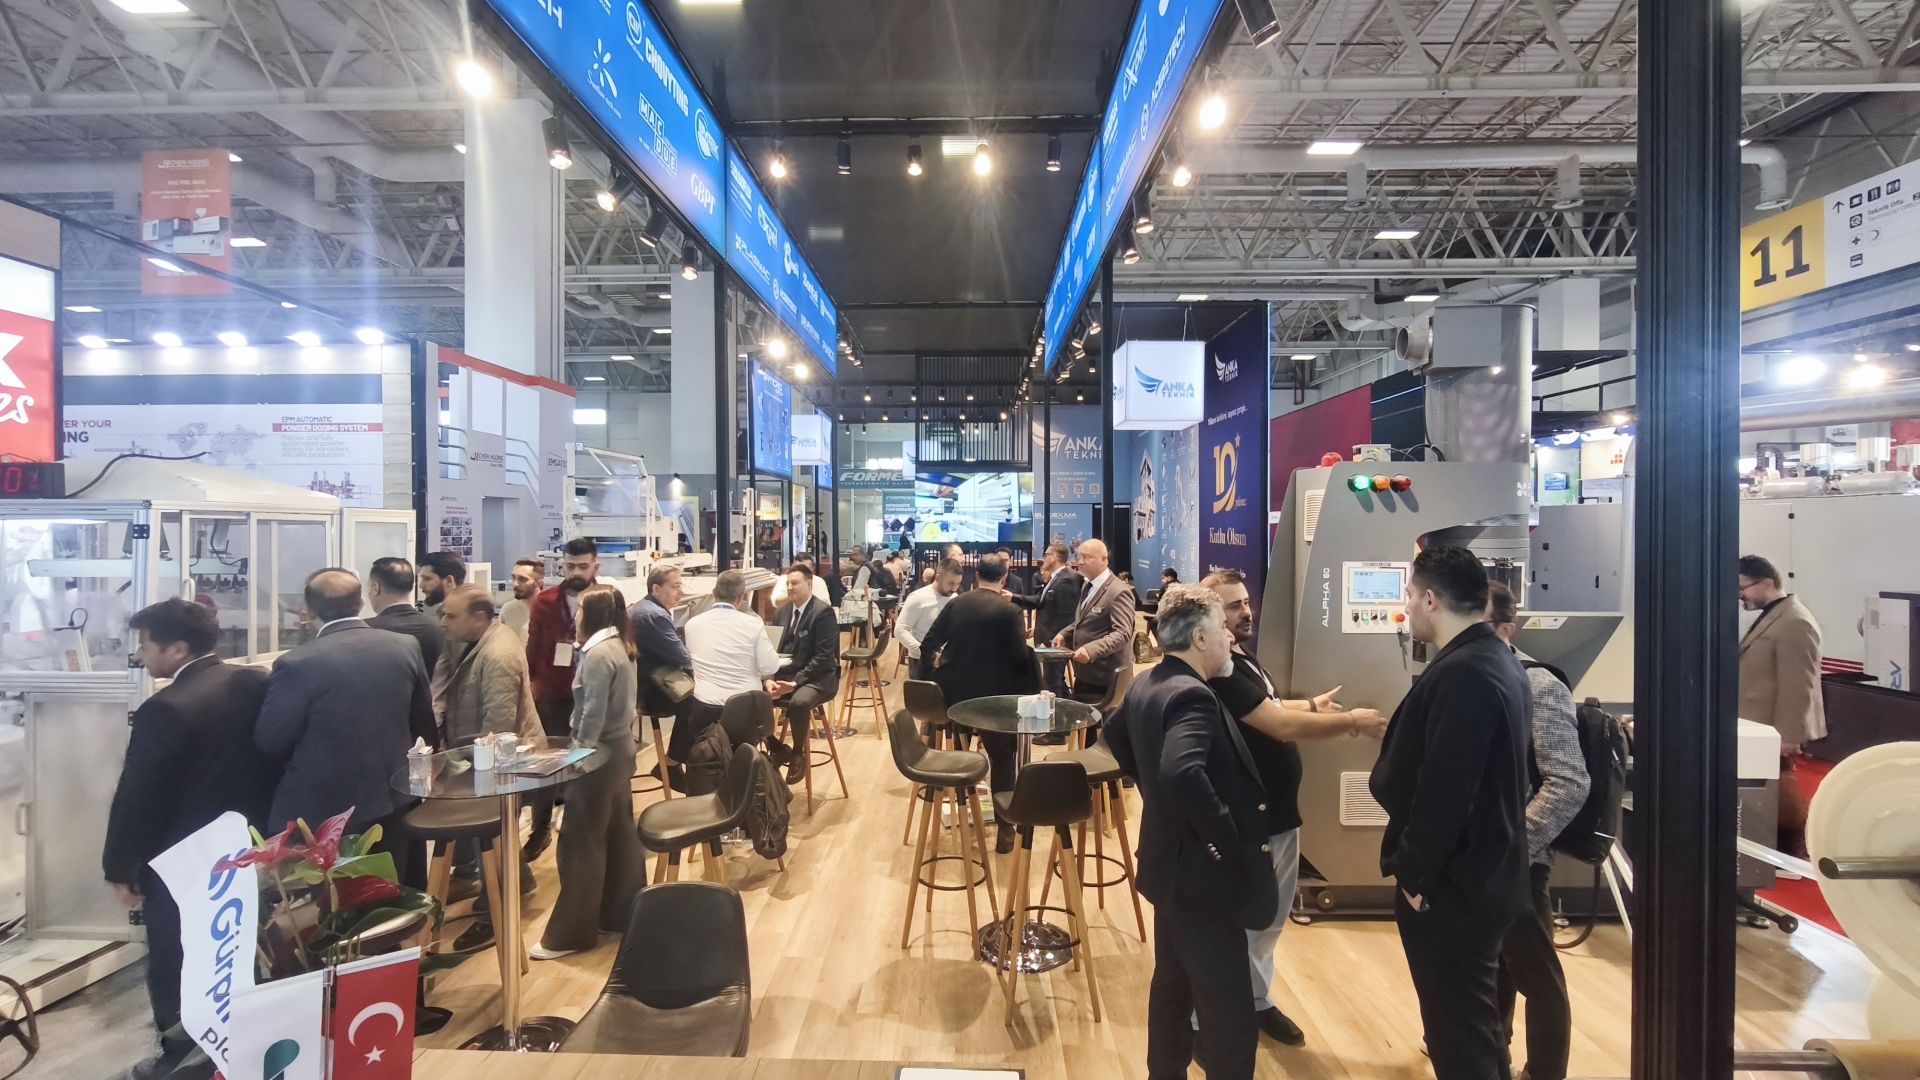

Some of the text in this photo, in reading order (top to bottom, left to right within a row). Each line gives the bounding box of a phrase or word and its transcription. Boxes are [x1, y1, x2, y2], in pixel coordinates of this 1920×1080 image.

[1750, 225, 1809, 287] 11
[1162, 382, 1195, 391] ANKA
[64, 420, 112, 428] ER YOUR
[281, 424, 368, 432] POWDER DOSING SYSTEM
[1064, 450, 1102, 460] TEKNI
[840, 472, 904, 482] FORME
[1208, 527, 1247, 546] Kutlu Olsun
[1321, 581, 1330, 628] ALPHA
